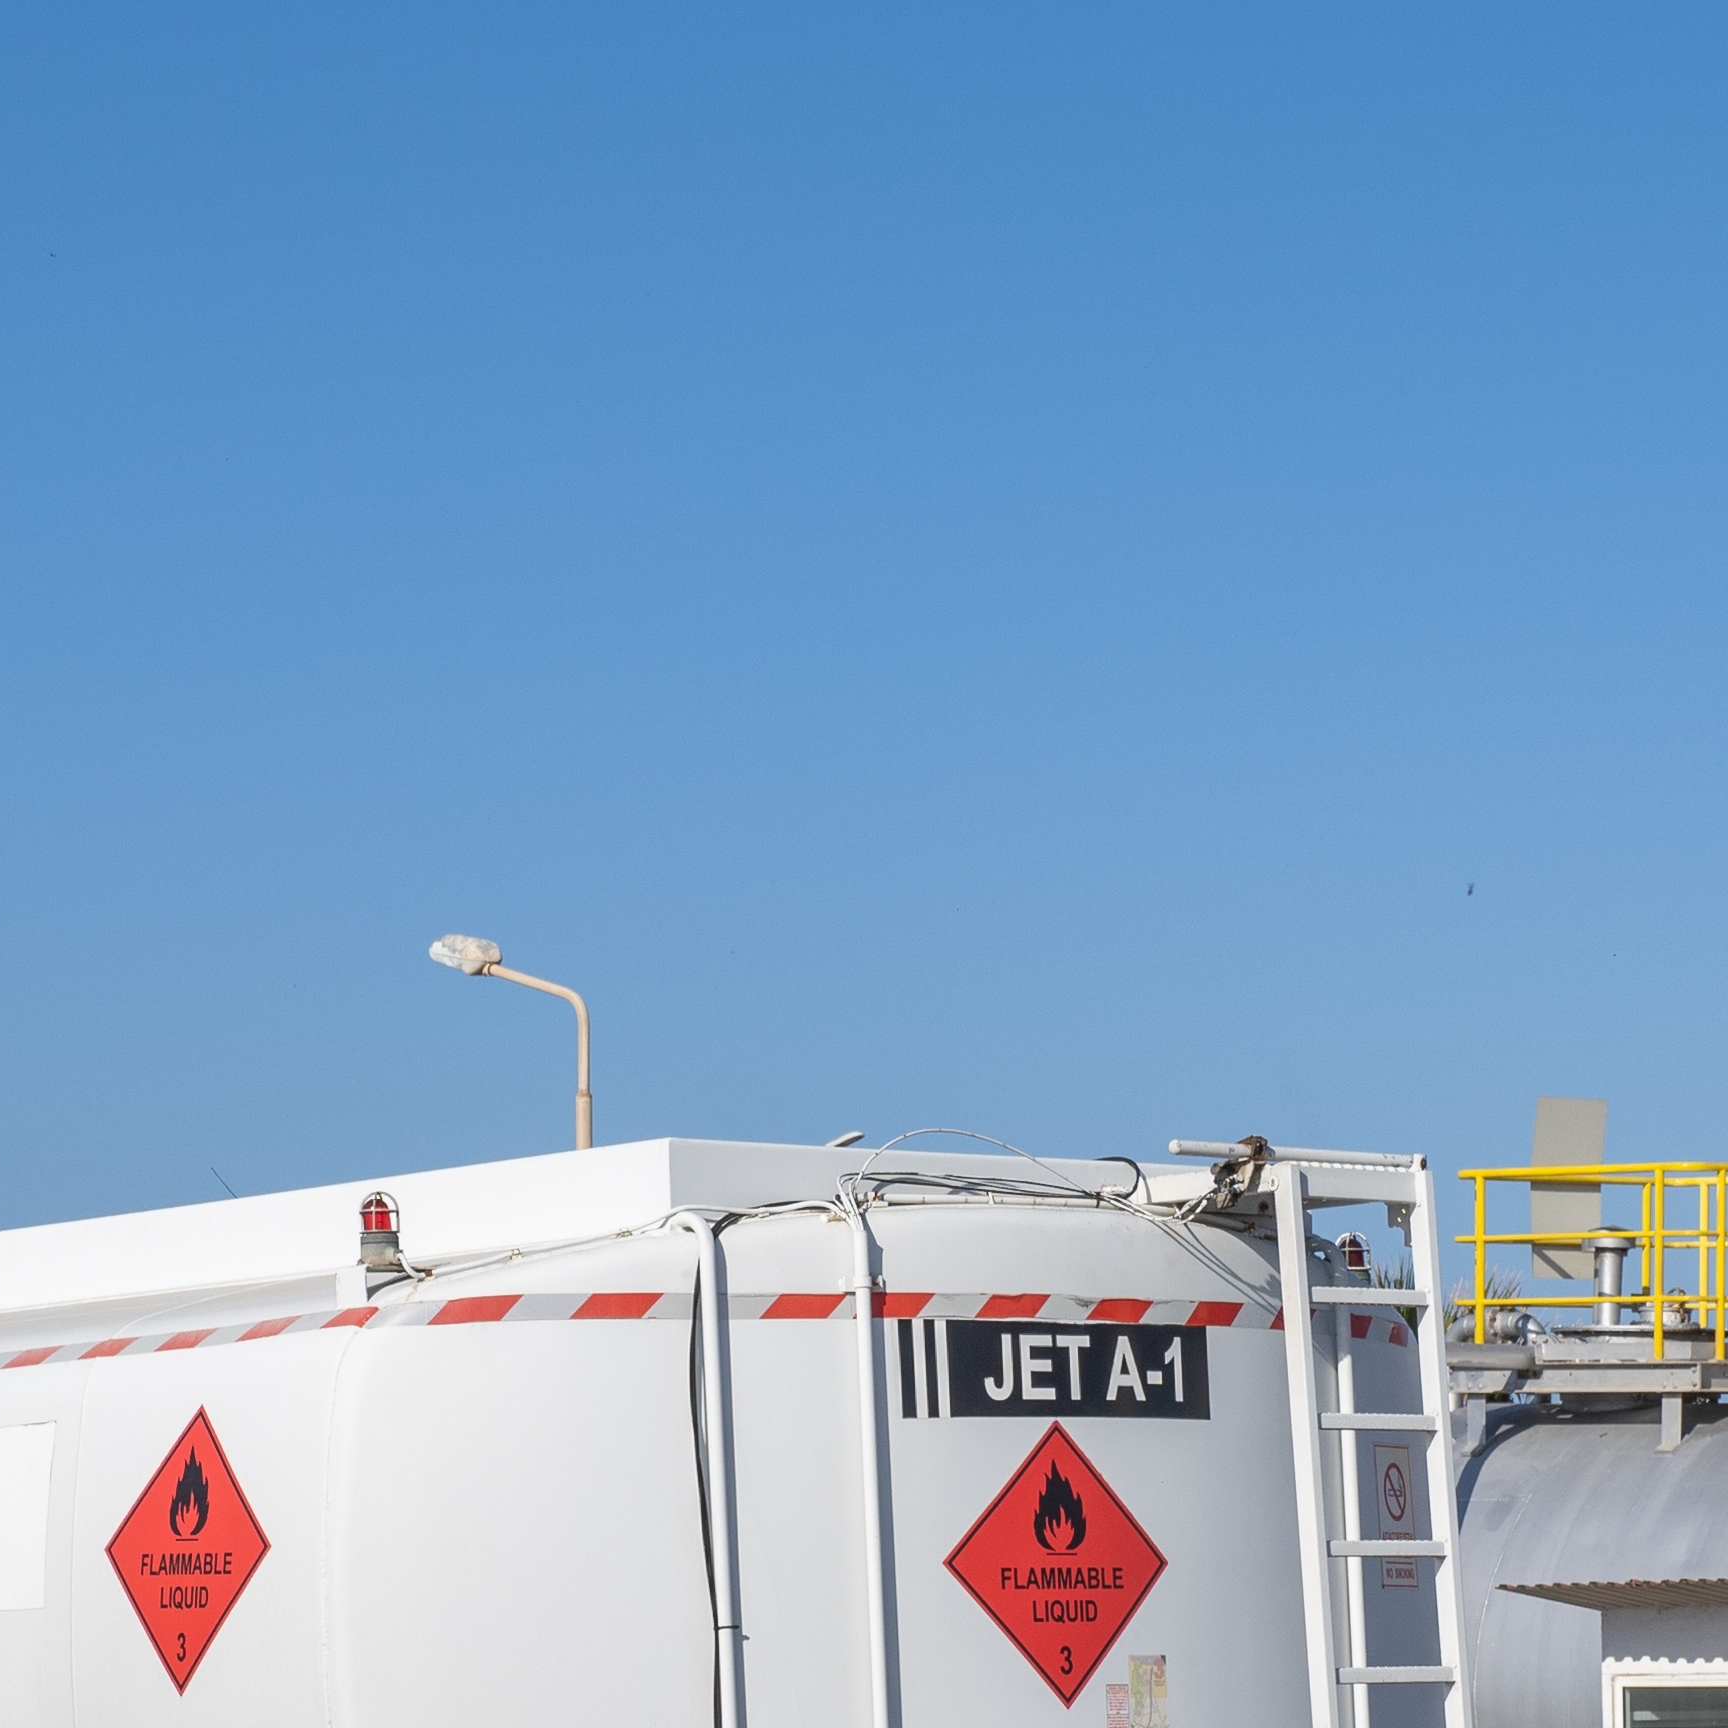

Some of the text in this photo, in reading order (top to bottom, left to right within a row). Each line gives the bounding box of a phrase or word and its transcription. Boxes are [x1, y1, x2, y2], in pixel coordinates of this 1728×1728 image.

[984, 1333, 1184, 1402] JET A-1
[141, 1552, 232, 1576] FLAMMABLE
[1000, 1567, 1124, 1590] FLAMMABLE
[160, 1586, 209, 1610] LIQUID
[1032, 1599, 1098, 1624] LIQUID
[176, 1633, 186, 1662] 3
[1059, 1645, 1074, 1676] 3
